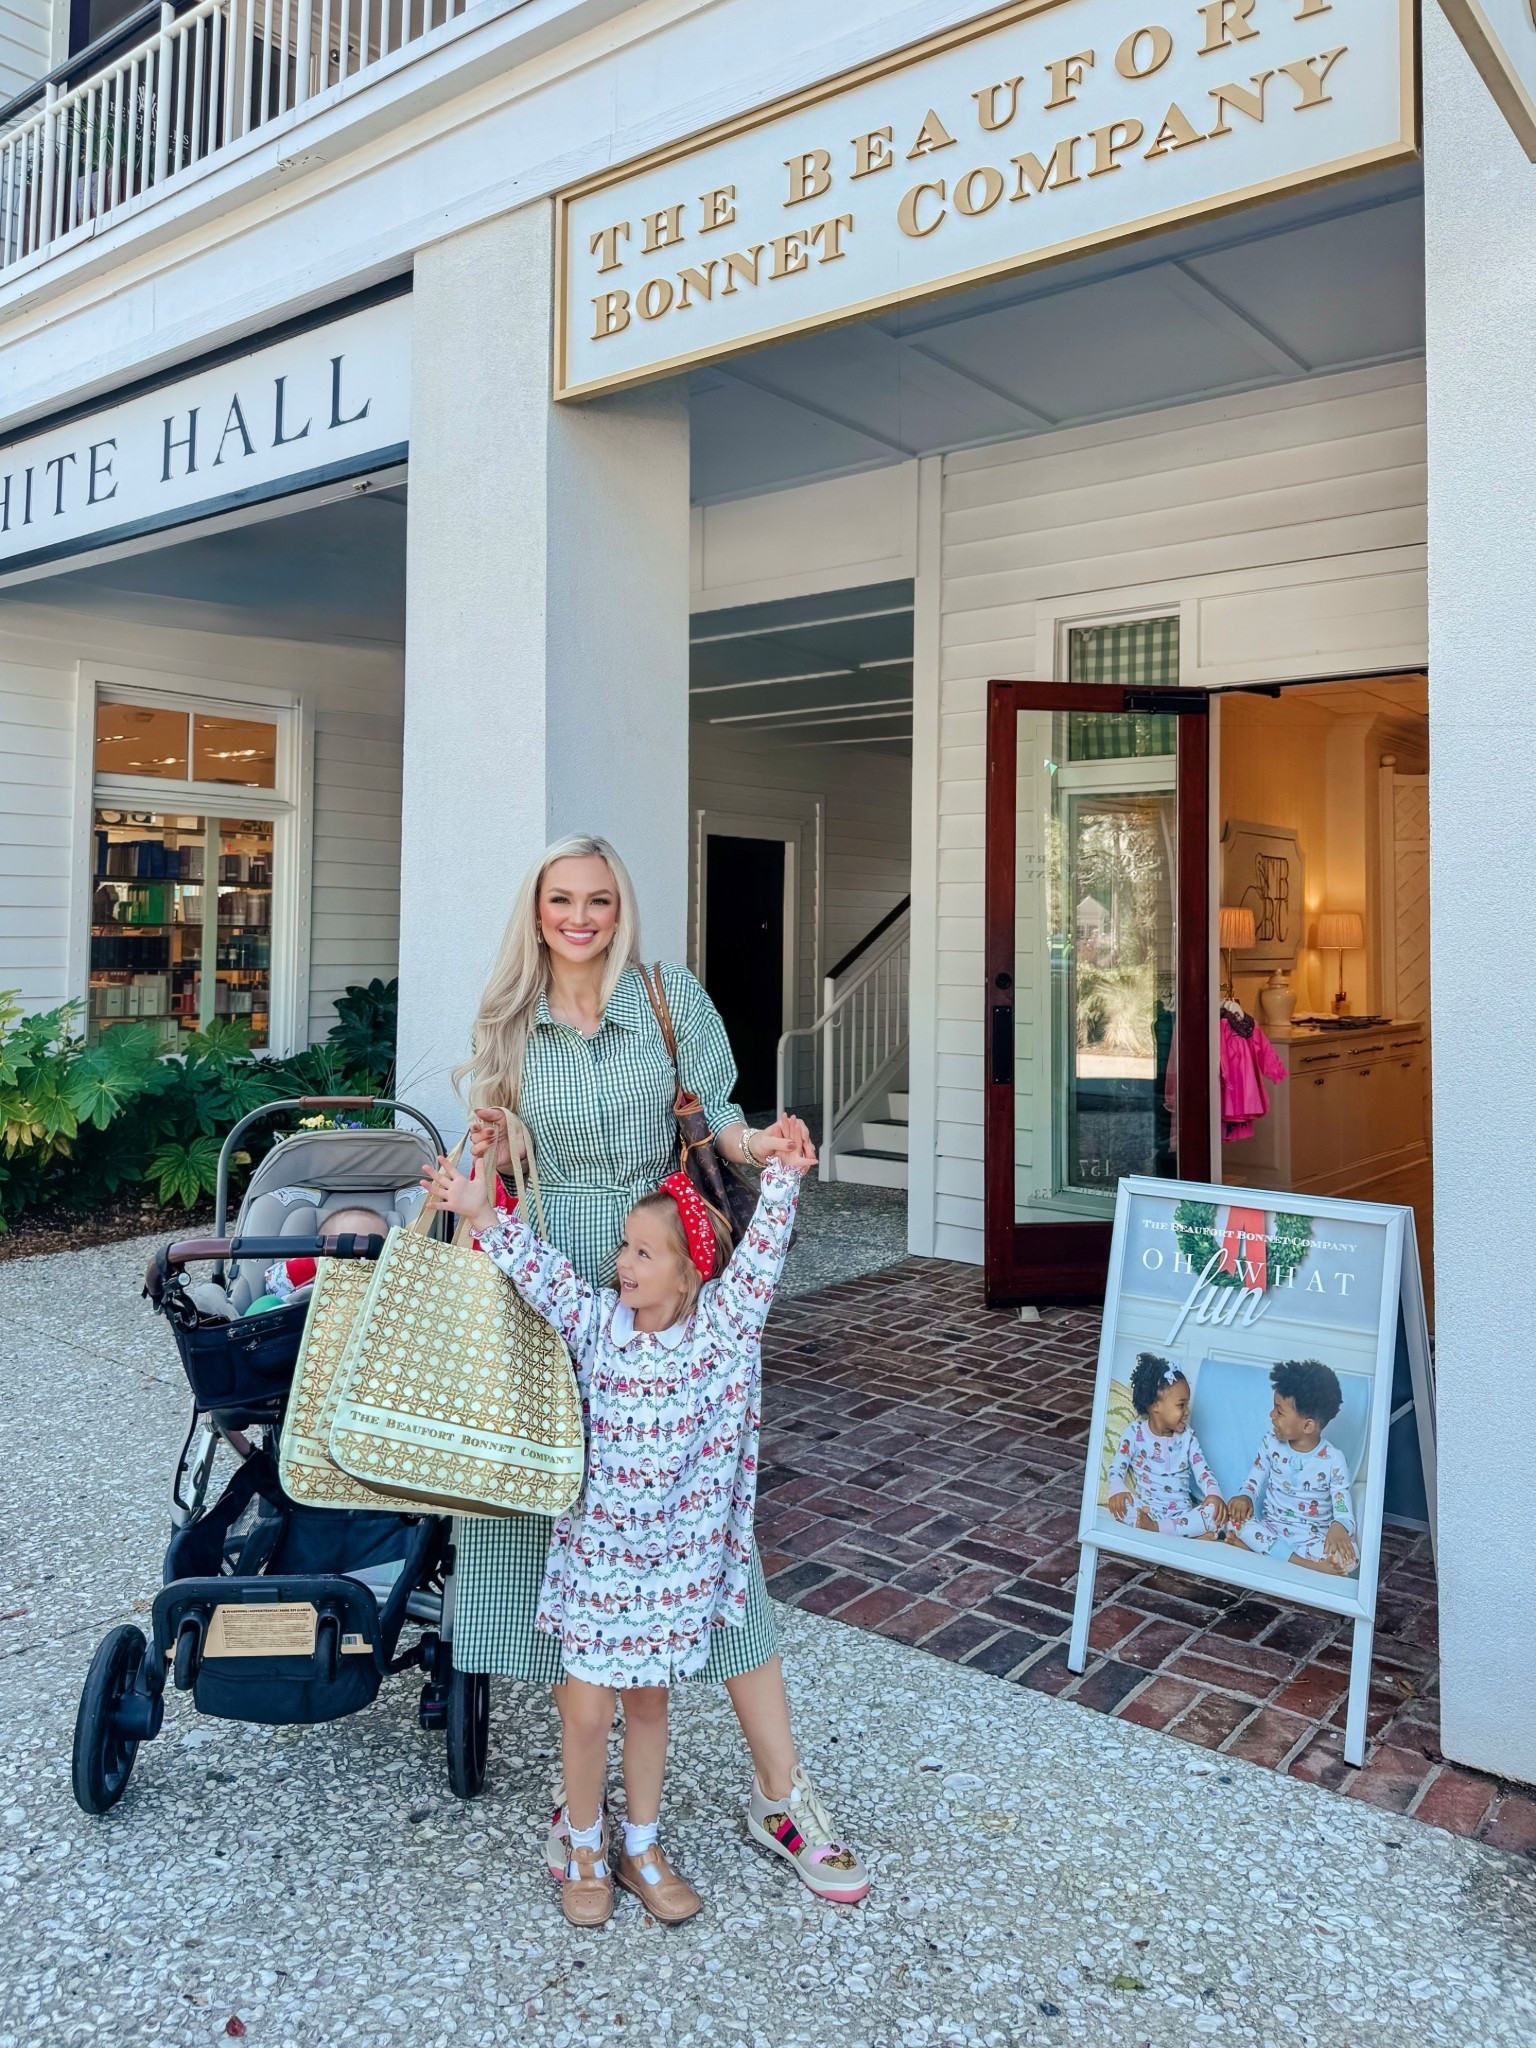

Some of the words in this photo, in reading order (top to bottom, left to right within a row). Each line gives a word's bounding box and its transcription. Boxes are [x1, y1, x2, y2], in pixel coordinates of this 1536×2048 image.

[589, 213, 855, 341] BONNET
[897, 45, 1349, 238] COMPANY
[589, 184, 737, 274] THE
[160, 354, 372, 484] HALL
[1142, 1219, 1168, 1231] THE
[1170, 1222, 1235, 1239] BEAUFORT
[1236, 1230, 1290, 1245] BONNET
[1291, 1237, 1358, 1253] COMPANY
[1142, 1247, 1194, 1275] OH
[1233, 1259, 1355, 1297] WHAT
[1162, 1247, 1272, 1346] fun
[350, 1410, 380, 1425] THE
[386, 1418, 455, 1441] BEAUFORT
[461, 1434, 515, 1454] BONNET
[521, 1446, 574, 1465] COMPANY
